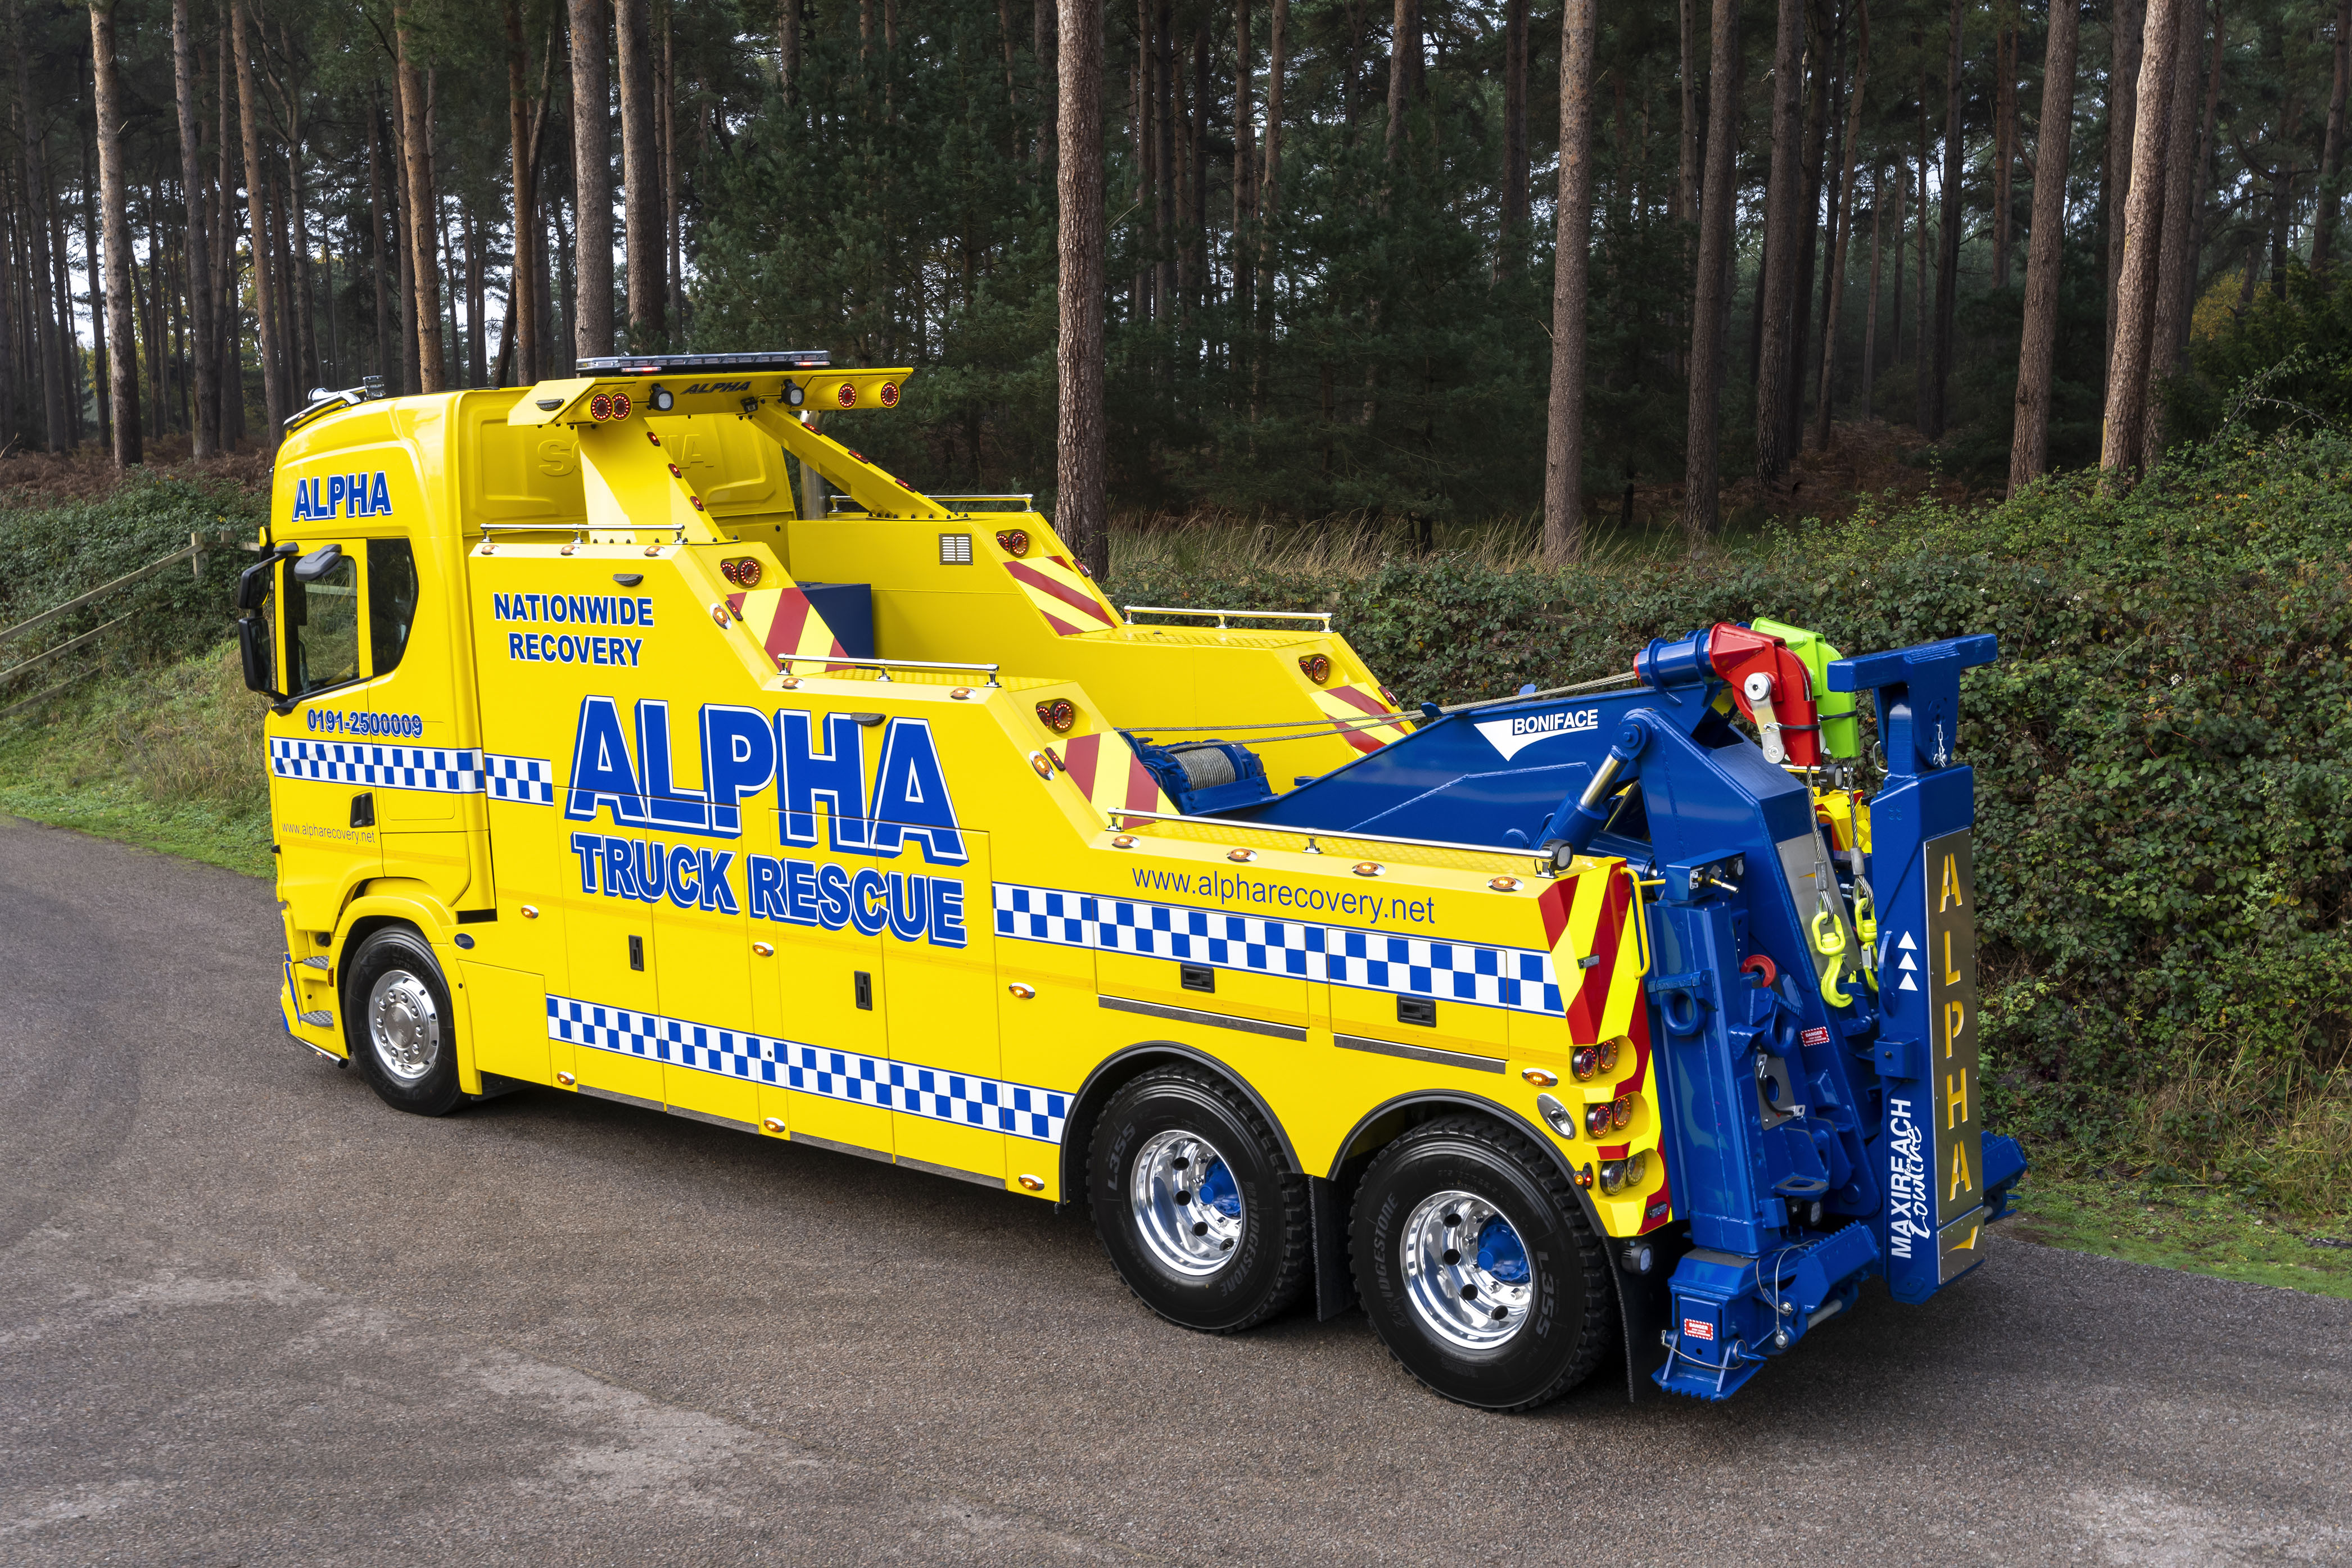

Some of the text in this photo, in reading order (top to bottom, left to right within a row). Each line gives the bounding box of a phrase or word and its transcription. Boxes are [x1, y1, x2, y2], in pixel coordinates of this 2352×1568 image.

[680, 380, 752, 395] ALPHA
[292, 470, 393, 523] ALPHA
[493, 592, 654, 627] NATIONWIDE
[508, 632, 643, 668] RECOVERY
[307, 708, 423, 738] 0191-2500009
[1514, 709, 1598, 735] BONIFACE
[564, 695, 969, 867] ALPHA
[282, 822, 376, 844] www.alpharecovery.net
[571, 831, 968, 949] TRUCK RESCUE
[1132, 868, 1435, 924] www.alpharecovery.net
[1939, 853, 1973, 1202] ALPHA
[1108, 1122, 1136, 1191] L355
[1890, 1099, 1911, 1258] MAXIREACH
[1220, 1181, 1259, 1297] BRIDGESTONE
[1373, 1192, 1409, 1327] BRIDGESTONE
[1535, 1252, 1554, 1338] L355
